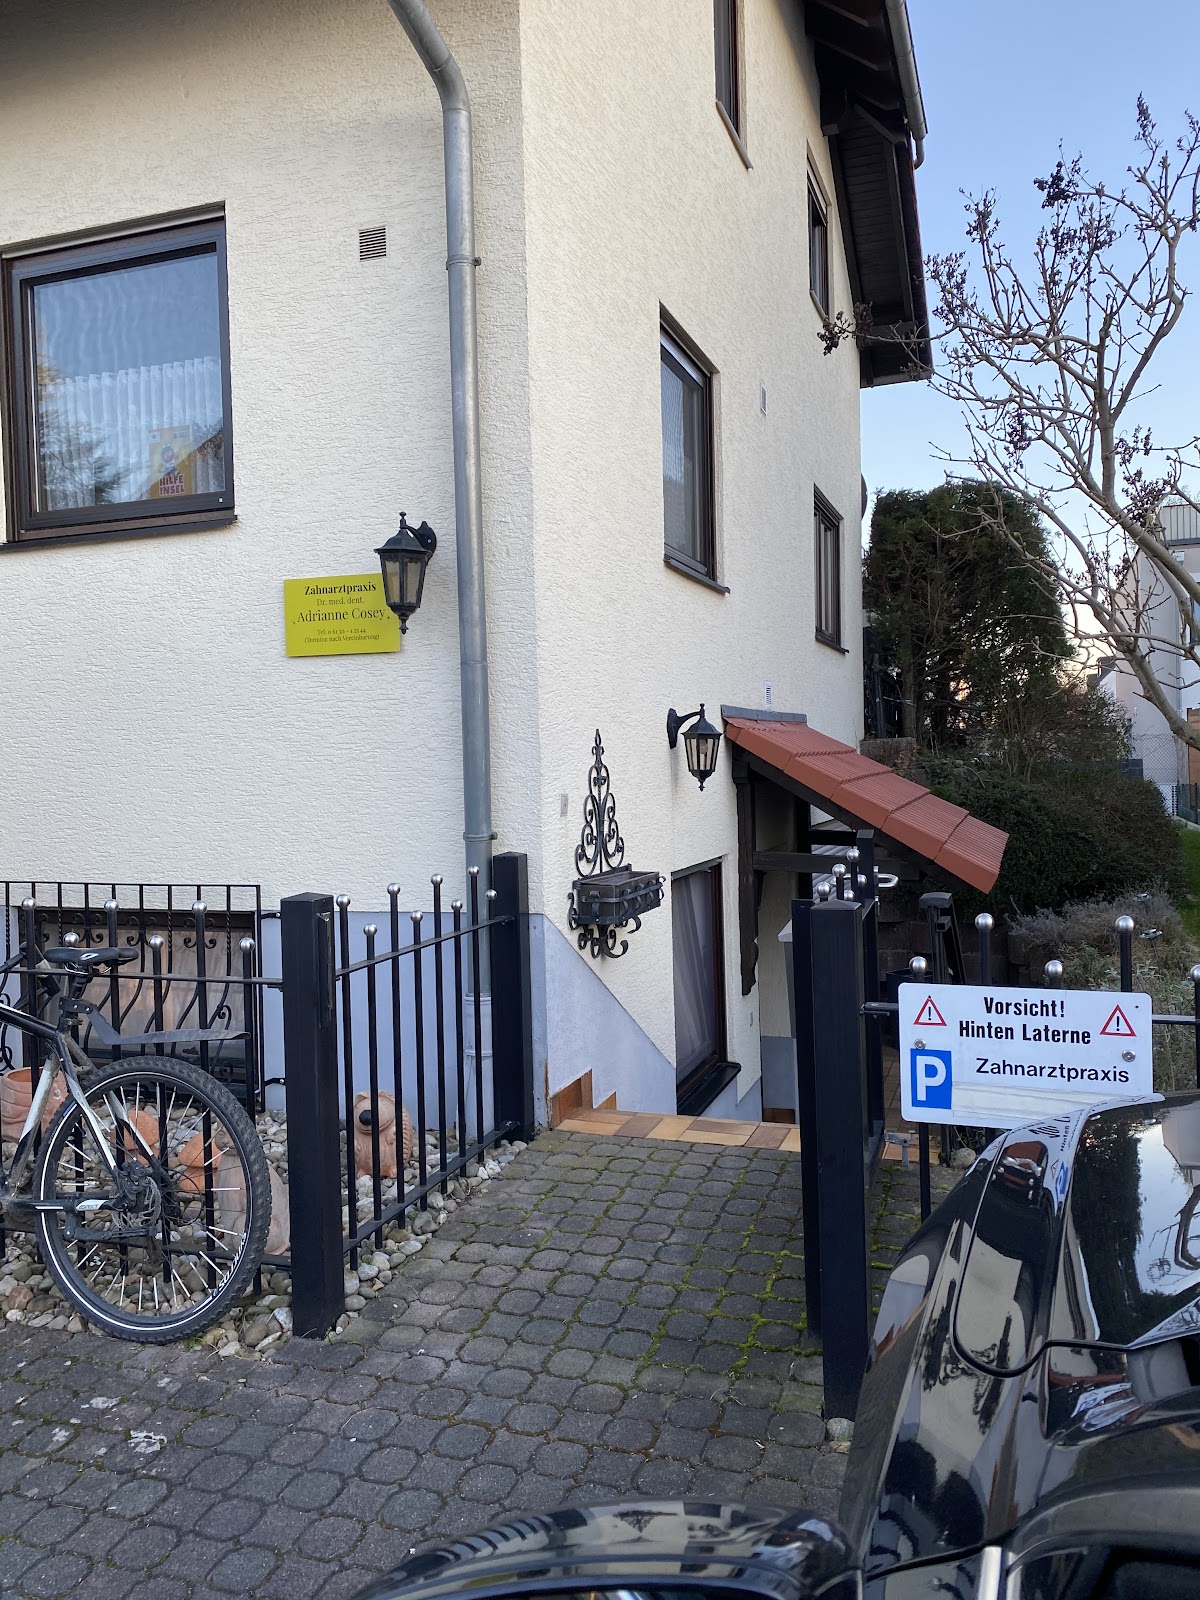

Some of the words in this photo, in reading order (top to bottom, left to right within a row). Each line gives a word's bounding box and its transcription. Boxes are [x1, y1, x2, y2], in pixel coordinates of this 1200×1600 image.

[160, 475, 184, 486] HILFE
[160, 485, 185, 496] INSEL
[304, 581, 377, 596] Zahnarztpraxis
[328, 597, 346, 606] med.
[297, 609, 348, 622] Adrianne
[352, 608, 386, 620] Cosey
[983, 996, 1066, 1018] Vorsicht!
[958, 1020, 1015, 1041] Hinten
[1022, 1024, 1092, 1045] Laterne
[976, 1057, 1130, 1083] Zahnarztpraxis
[916, 1055, 947, 1102] P
